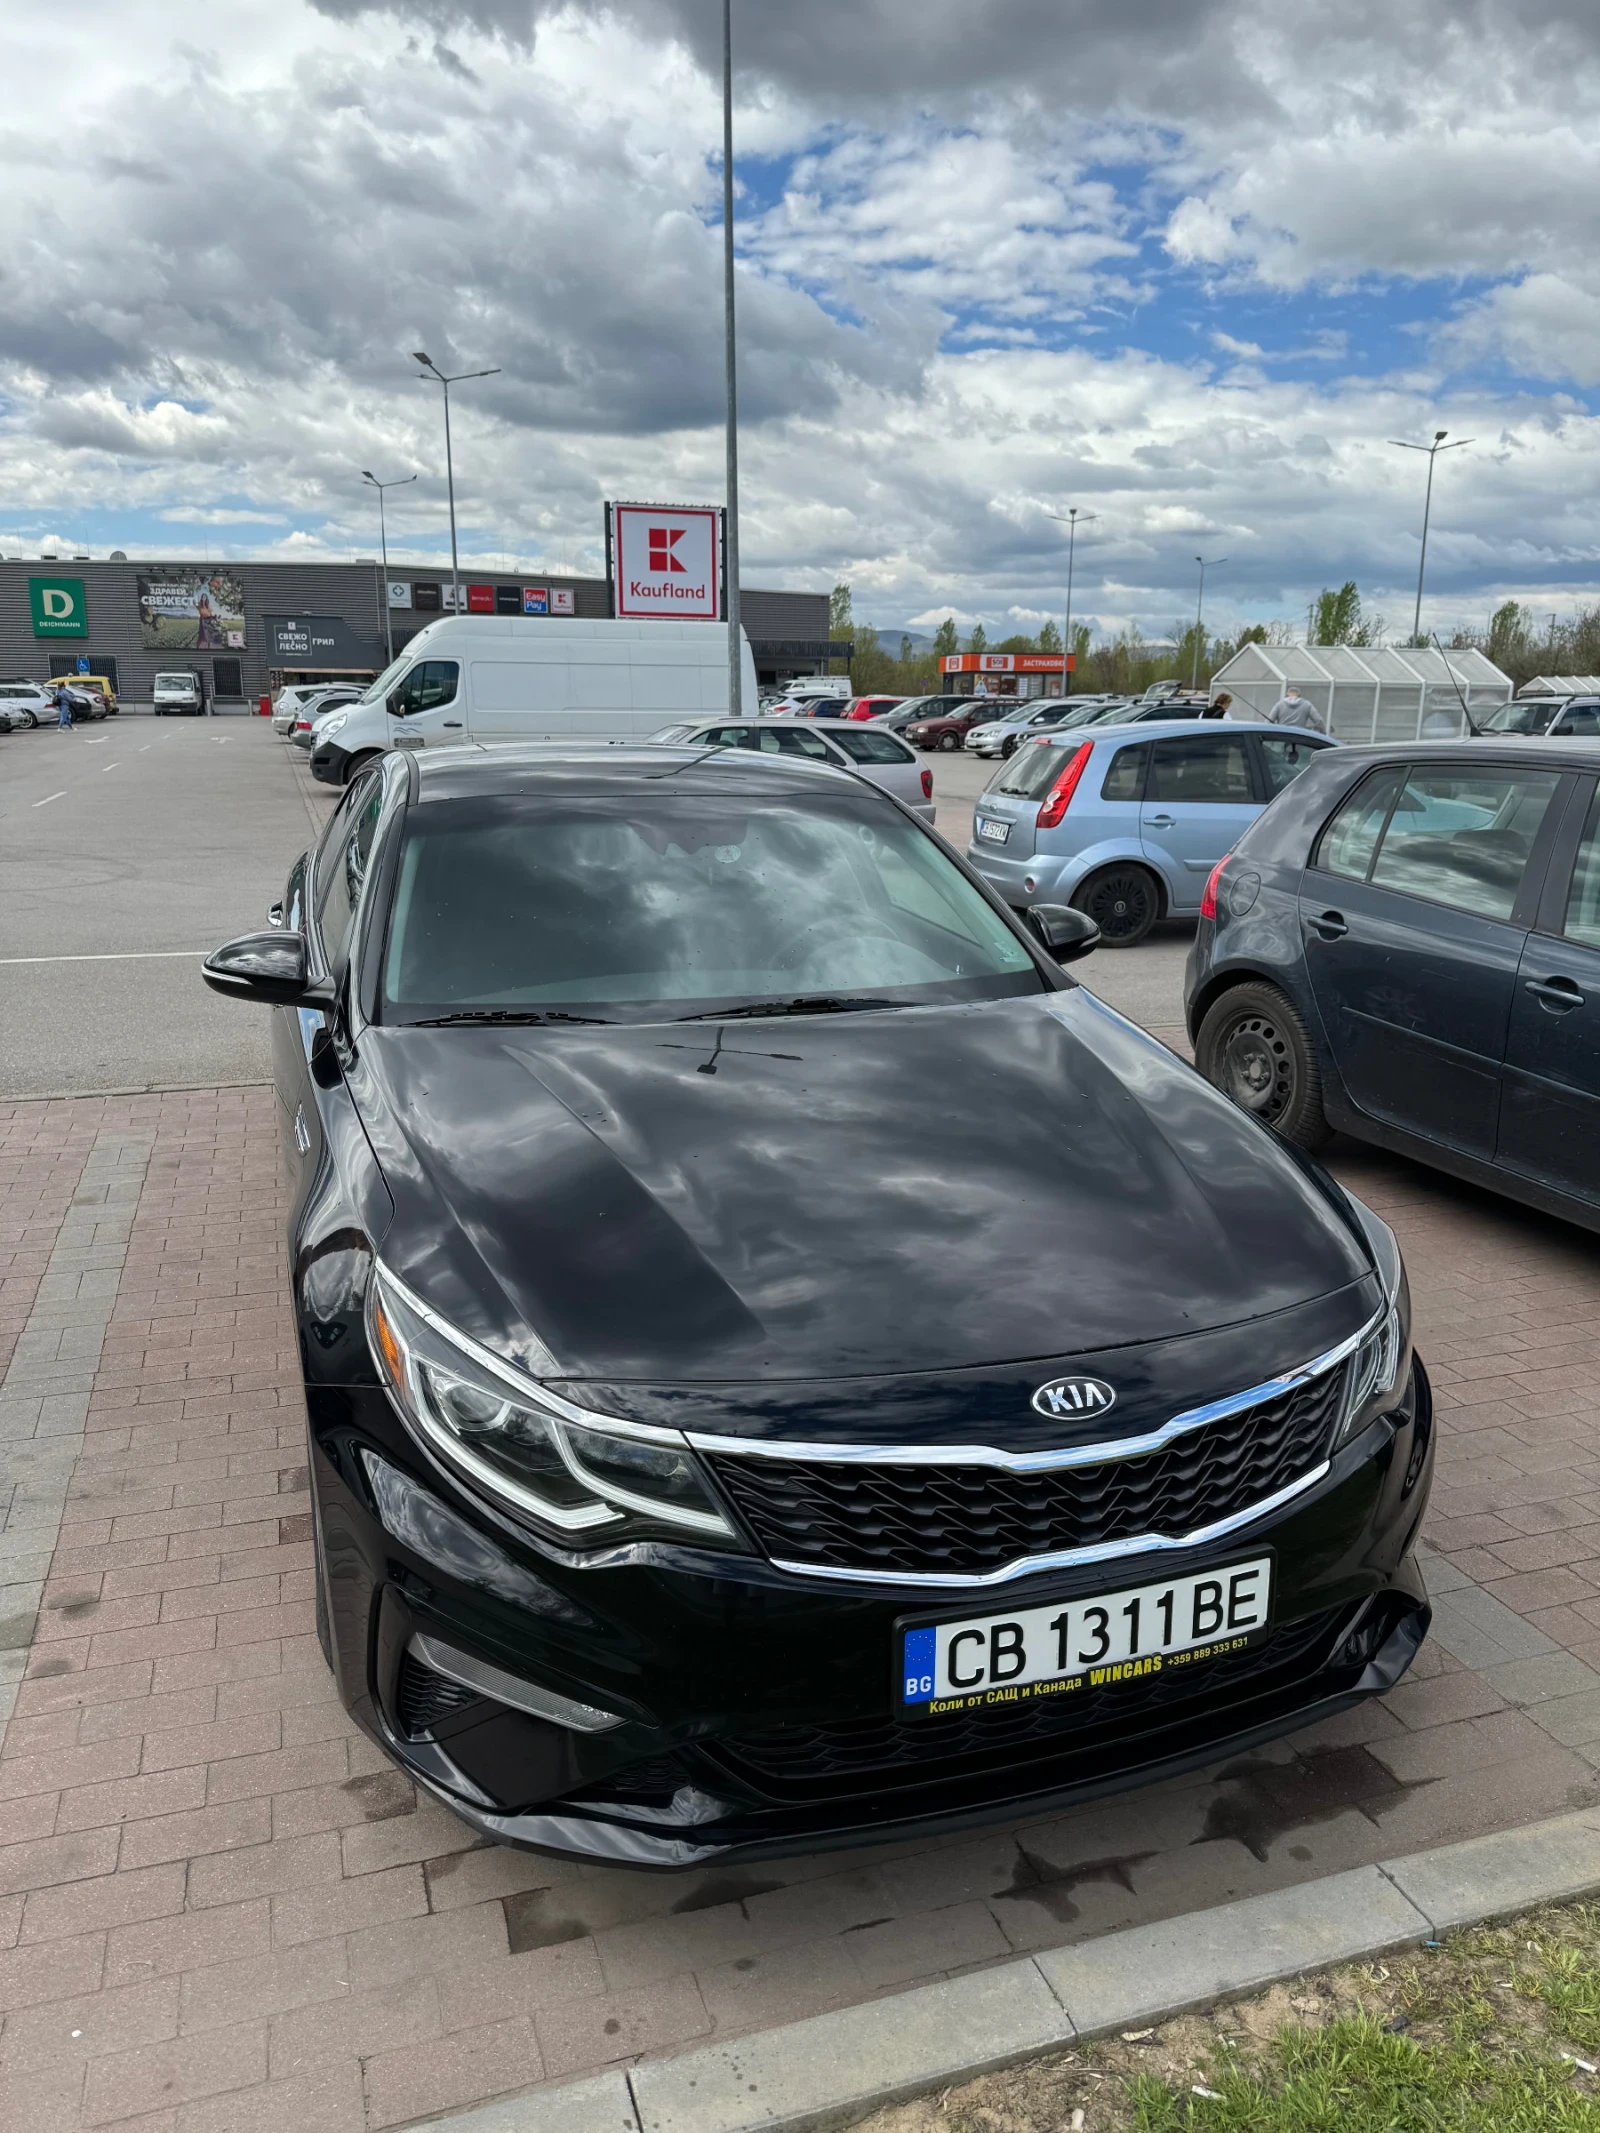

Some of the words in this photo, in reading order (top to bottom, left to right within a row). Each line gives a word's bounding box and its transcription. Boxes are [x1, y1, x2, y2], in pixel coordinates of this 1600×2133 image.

[526, 592, 546, 602] Easy
[630, 581, 705, 599] Kaufland
[42, 589, 74, 618] D
[526, 601, 542, 611] Pay
[278, 632, 308, 641] СВЕЖО
[312, 637, 335, 646] ГРИЛ
[279, 642, 308, 651] ЛЕСНО
[1044, 1382, 1107, 1413] KIA
[948, 1622, 1027, 1688] CB
[1050, 1589, 1174, 1670] 1311
[1192, 1569, 1259, 1639] BE
[929, 1699, 964, 1714] Коли
[967, 1695, 984, 1707] от
[986, 1688, 1018, 1703] САЩ
[1022, 1687, 1030, 1698] и
[1033, 1677, 1082, 1696] Канада
[1090, 1655, 1162, 1686] WINCARS
[1167, 1653, 1191, 1667] +359
[1194, 1647, 1210, 1660] 889
[1213, 1642, 1230, 1655] 333
[1232, 1636, 1248, 1650] 631
[906, 1675, 931, 1695] BG
